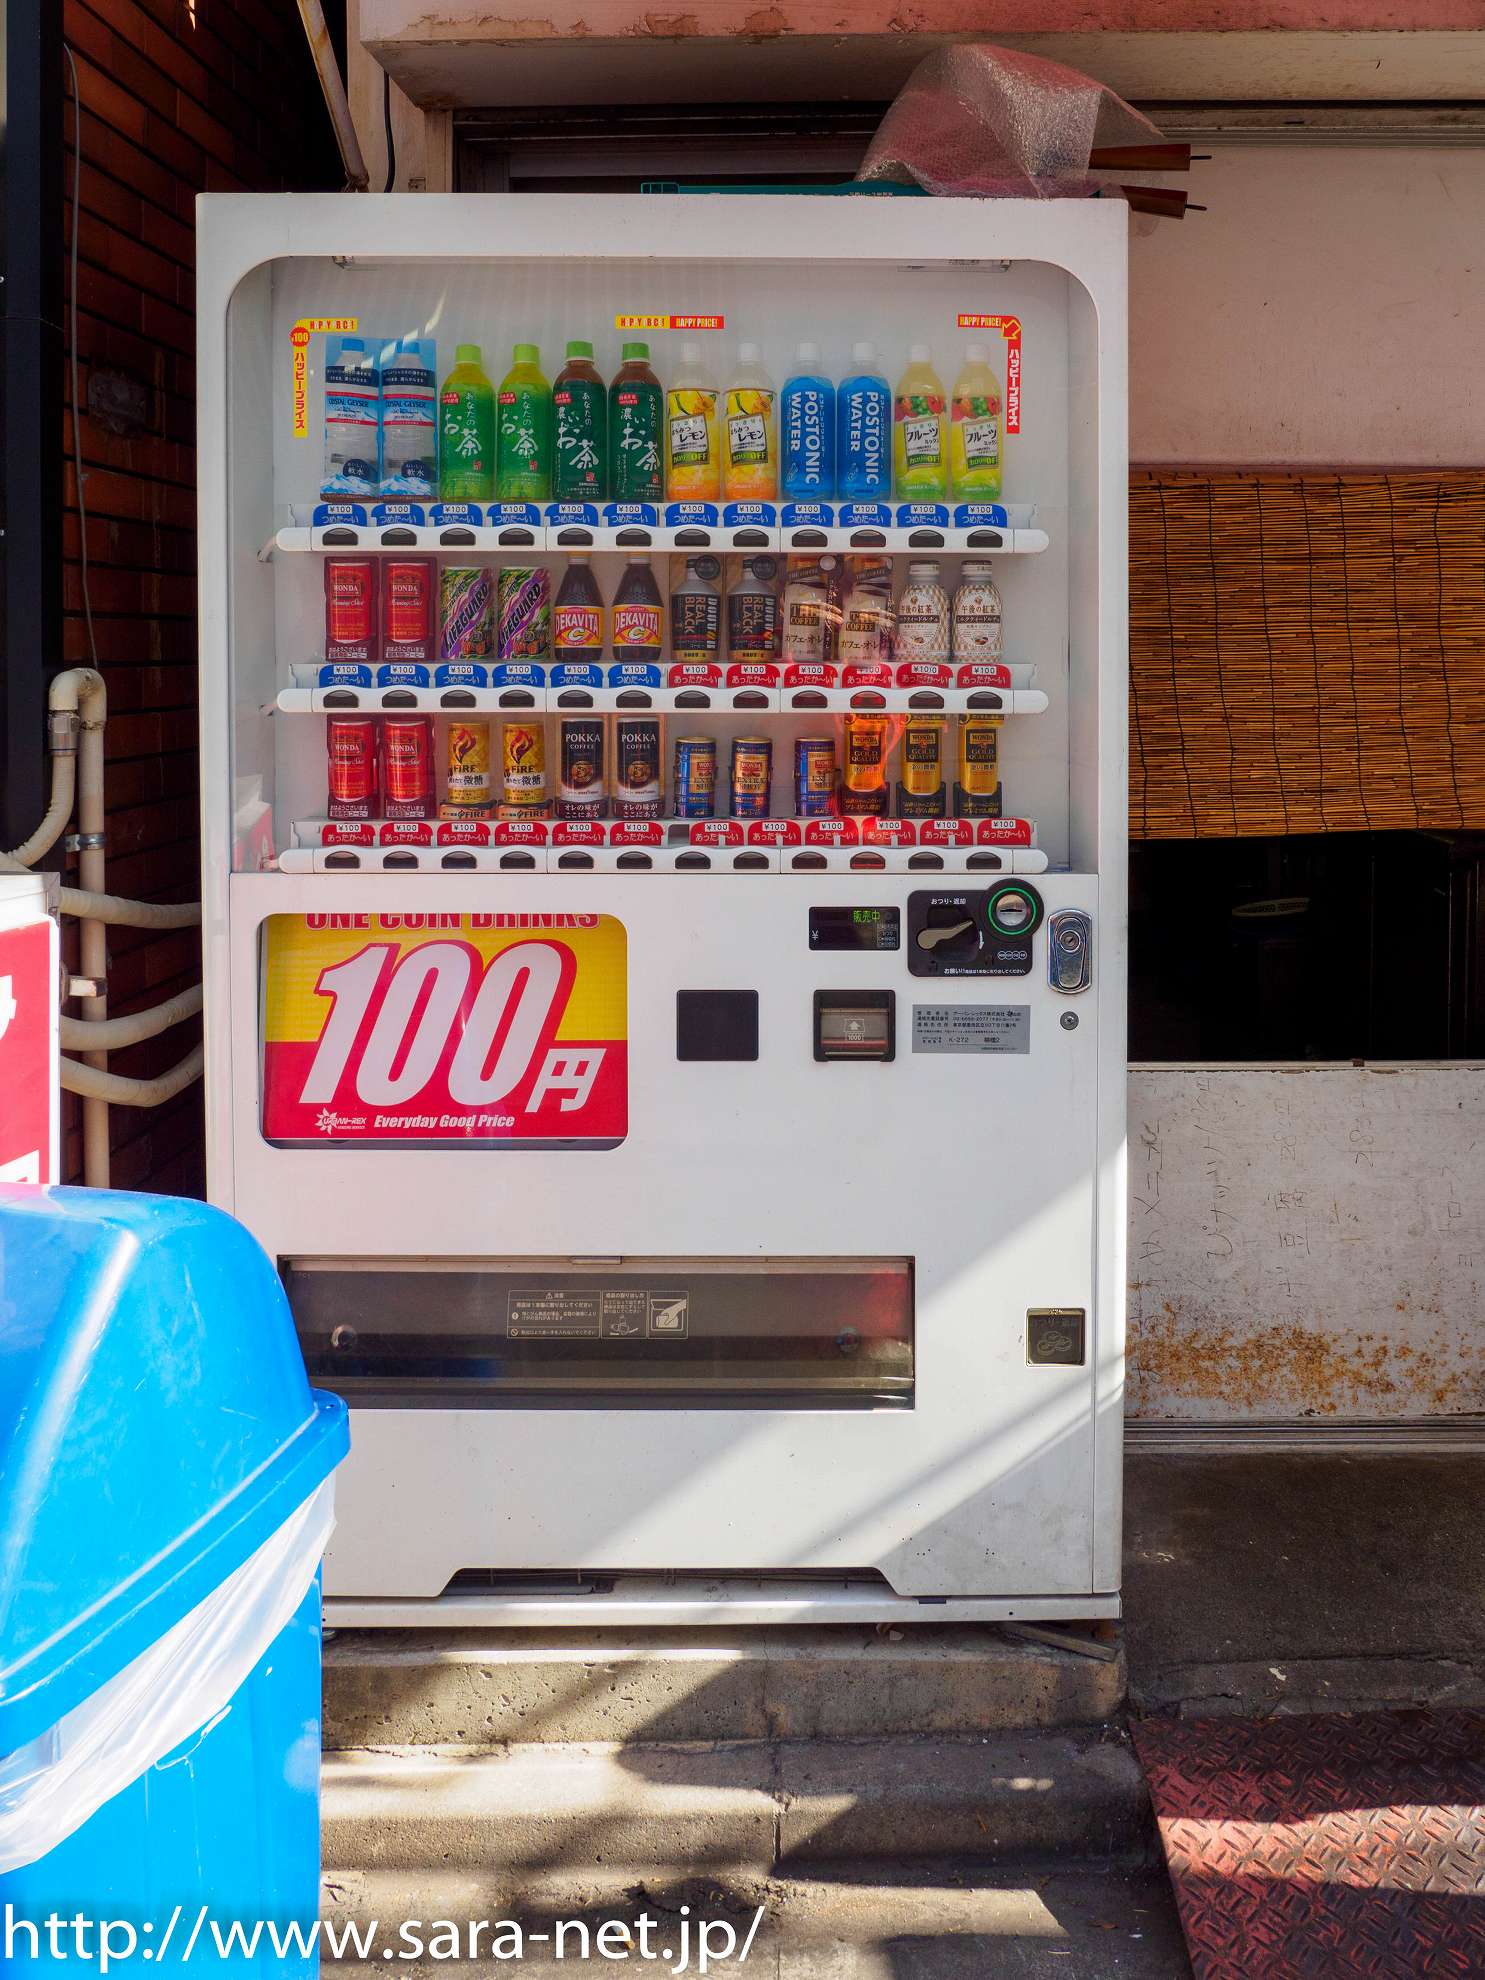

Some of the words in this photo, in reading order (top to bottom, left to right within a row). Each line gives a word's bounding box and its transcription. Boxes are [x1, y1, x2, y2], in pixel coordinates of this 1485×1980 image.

[960, 317, 980, 325] HAPPY
[981, 317, 1001, 326] PRICE!
[295, 352, 305, 429] ハッピープライス
[1008, 349, 1019, 426] ハッピープライス
[466, 393, 475, 426] あなたの
[522, 393, 532, 427] あなたの
[582, 393, 592, 426] あなたの
[790, 392, 801, 451] WATER
[444, 409, 483, 458] お茶
[501, 409, 539, 459] お茶
[850, 392, 863, 452] WATER
[680, 430, 705, 442] レモン
[738, 431, 764, 442] レモン
[805, 391, 820, 484] POSTONIC
[865, 392, 879, 485] POSTONIC
[907, 428, 938, 442] フルーツ
[967, 430, 997, 443] フルーツ
[445, 583, 489, 651] LIFEGUARD
[501, 584, 541, 649] LIFEGUARD
[685, 597, 696, 633] BLACK
[695, 597, 705, 624] REAL
[743, 597, 753, 634] BLACK
[753, 597, 763, 625] REAL
[790, 617, 819, 625] COFFEE
[962, 605, 996, 613] 午後の紅茶
[555, 613, 598, 634] DEKAVITA
[616, 612, 658, 636] DEKAVITA
[846, 623, 874, 631] COFFEE
[565, 733, 601, 742] POKKA
[622, 734, 656, 742] POKKA
[454, 765, 476, 773] FIRE
[512, 765, 535, 773] FIRE
[465, 810, 486, 818] FIRE
[565, 803, 600, 811] オレの味が
[853, 910, 880, 922] 販売中
[812, 930, 819, 940] ¥
[299, 941, 607, 1113] 100円
[374, 1114, 436, 1129] Everyday
[440, 1114, 475, 1128] Good
[478, 1114, 515, 1128] Price
